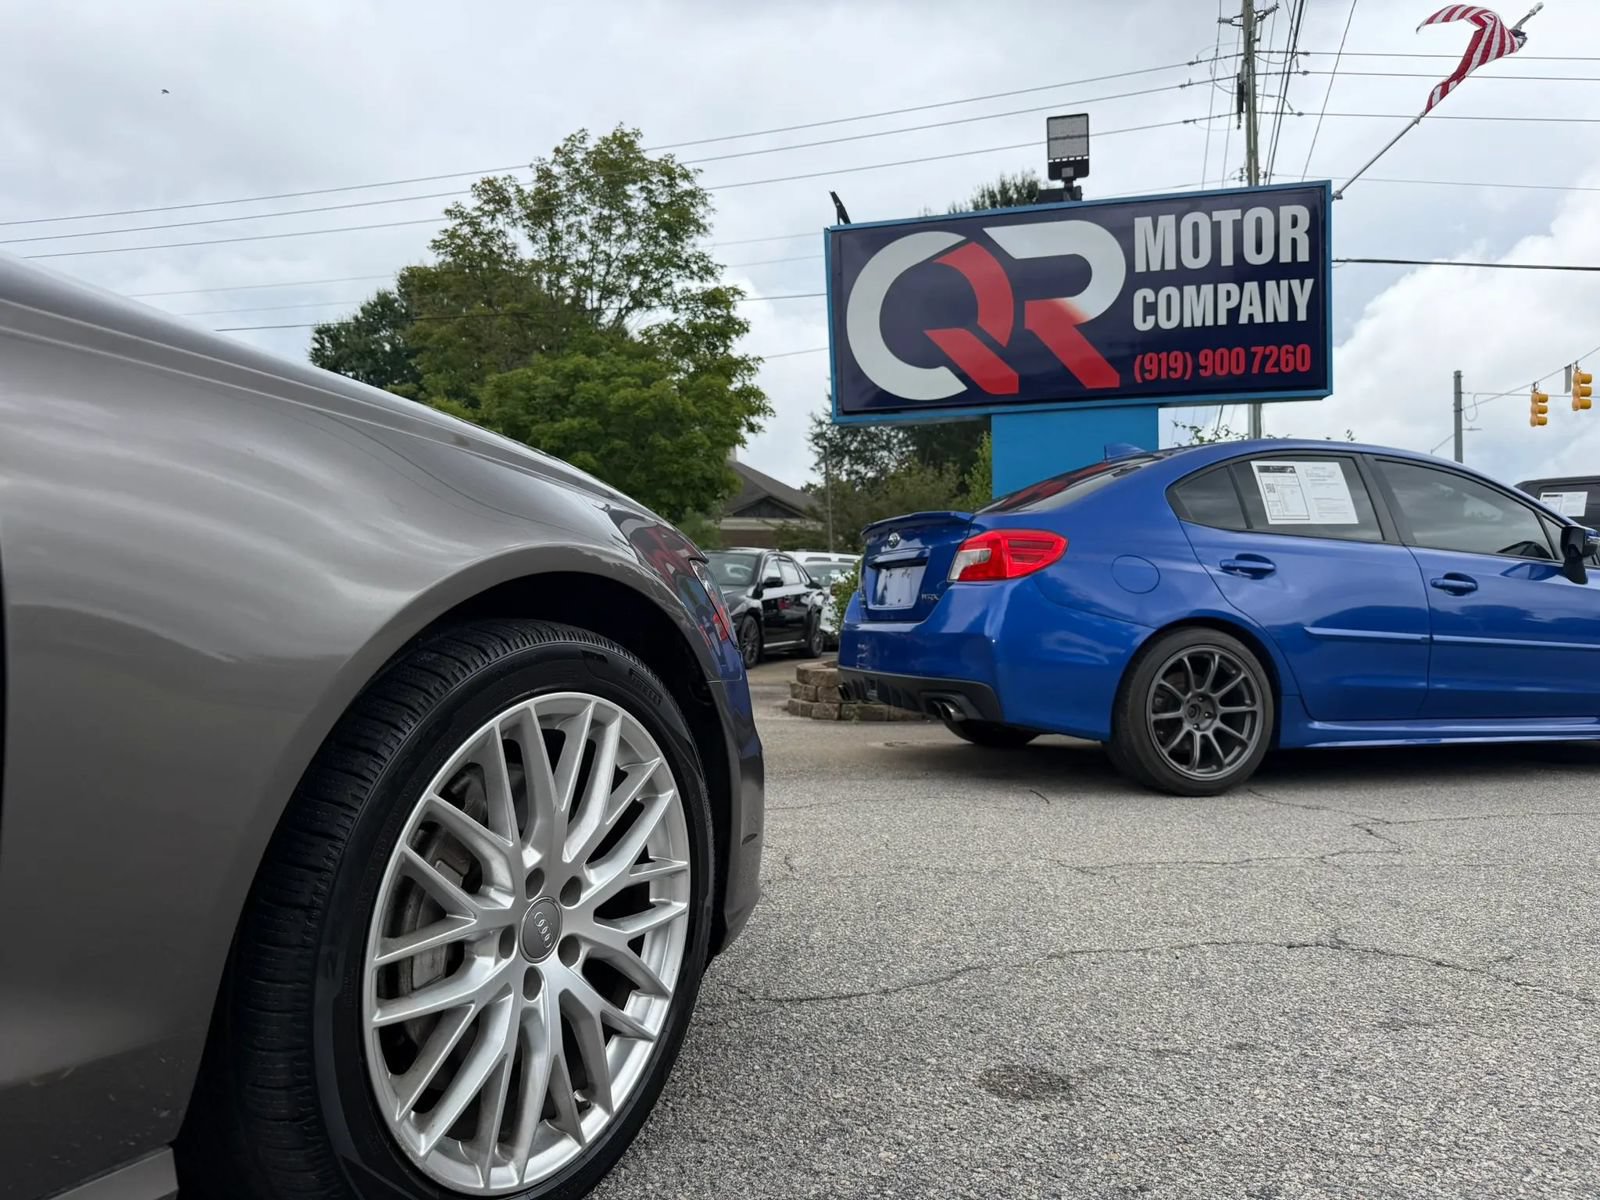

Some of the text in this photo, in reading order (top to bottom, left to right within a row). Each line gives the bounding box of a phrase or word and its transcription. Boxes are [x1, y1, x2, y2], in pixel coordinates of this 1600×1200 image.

[1134, 205, 1311, 273] MOTOR
[847, 220, 1126, 401] QR
[1133, 278, 1315, 332] COMPANY
[1134, 343, 1312, 383] (919) 900 7260
